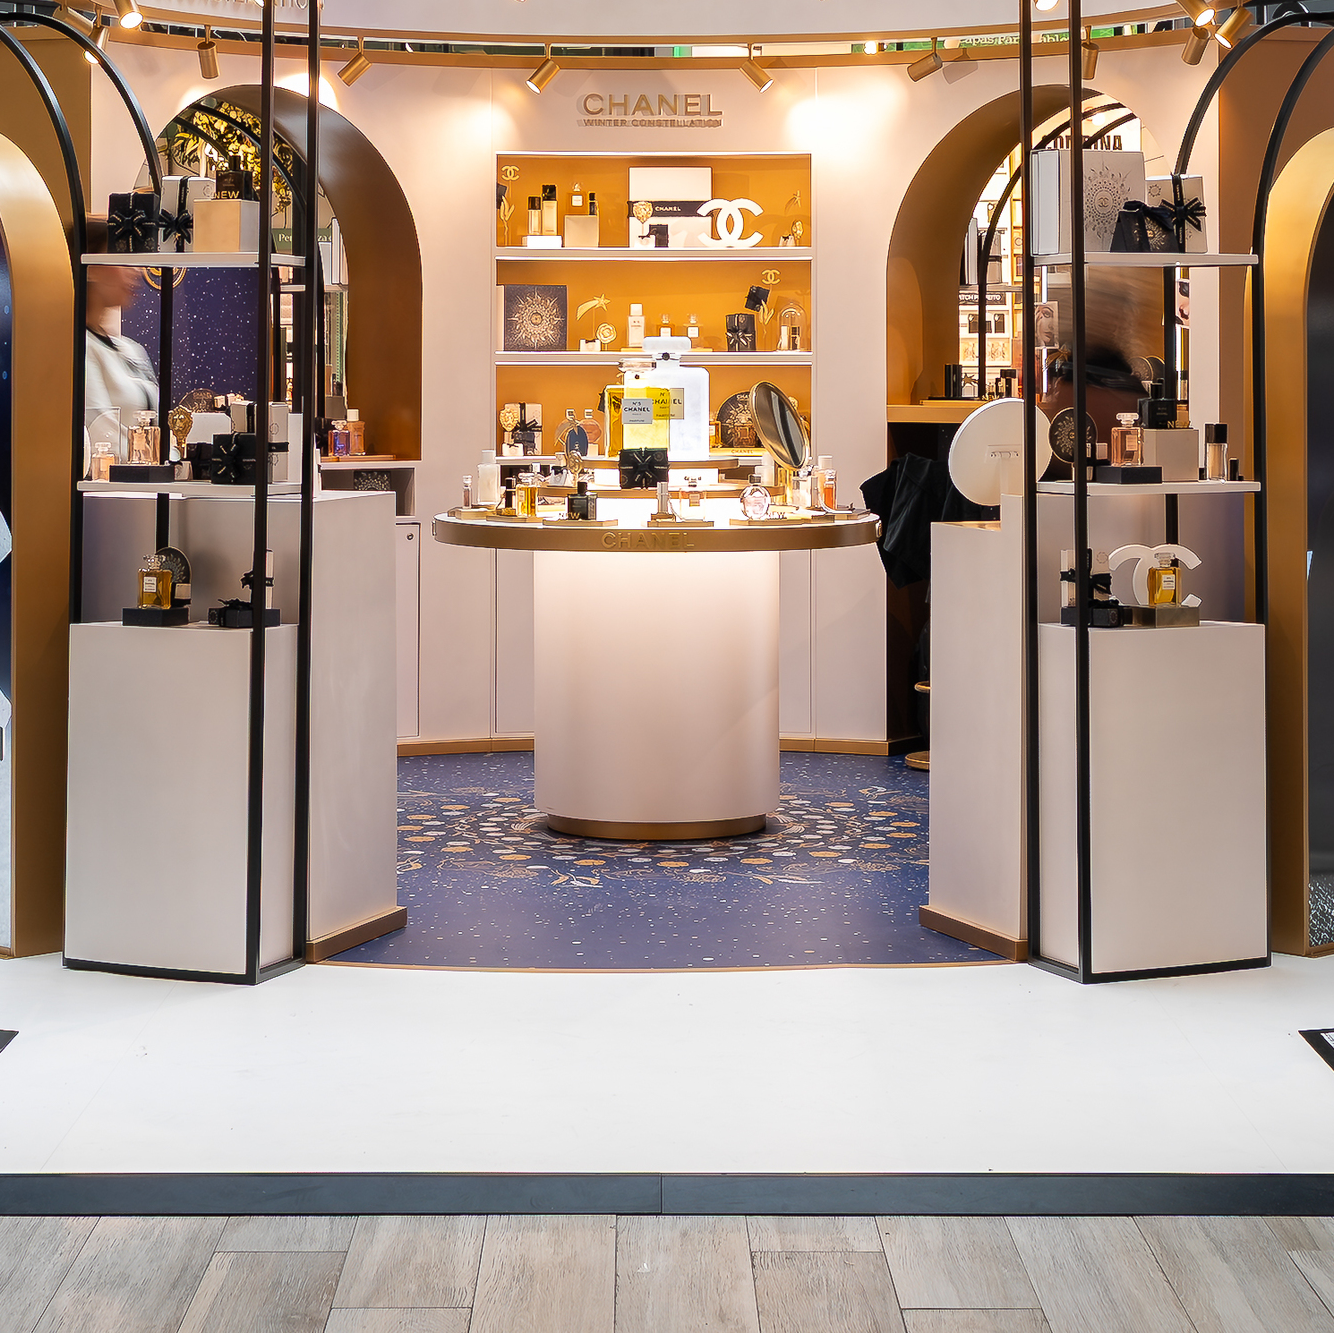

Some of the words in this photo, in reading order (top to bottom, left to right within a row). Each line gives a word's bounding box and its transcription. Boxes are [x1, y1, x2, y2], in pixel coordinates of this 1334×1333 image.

[584, 94, 722, 115] CHANEL
[631, 119, 722, 127] CONSTELLATION
[601, 531, 694, 549] CHANEL
